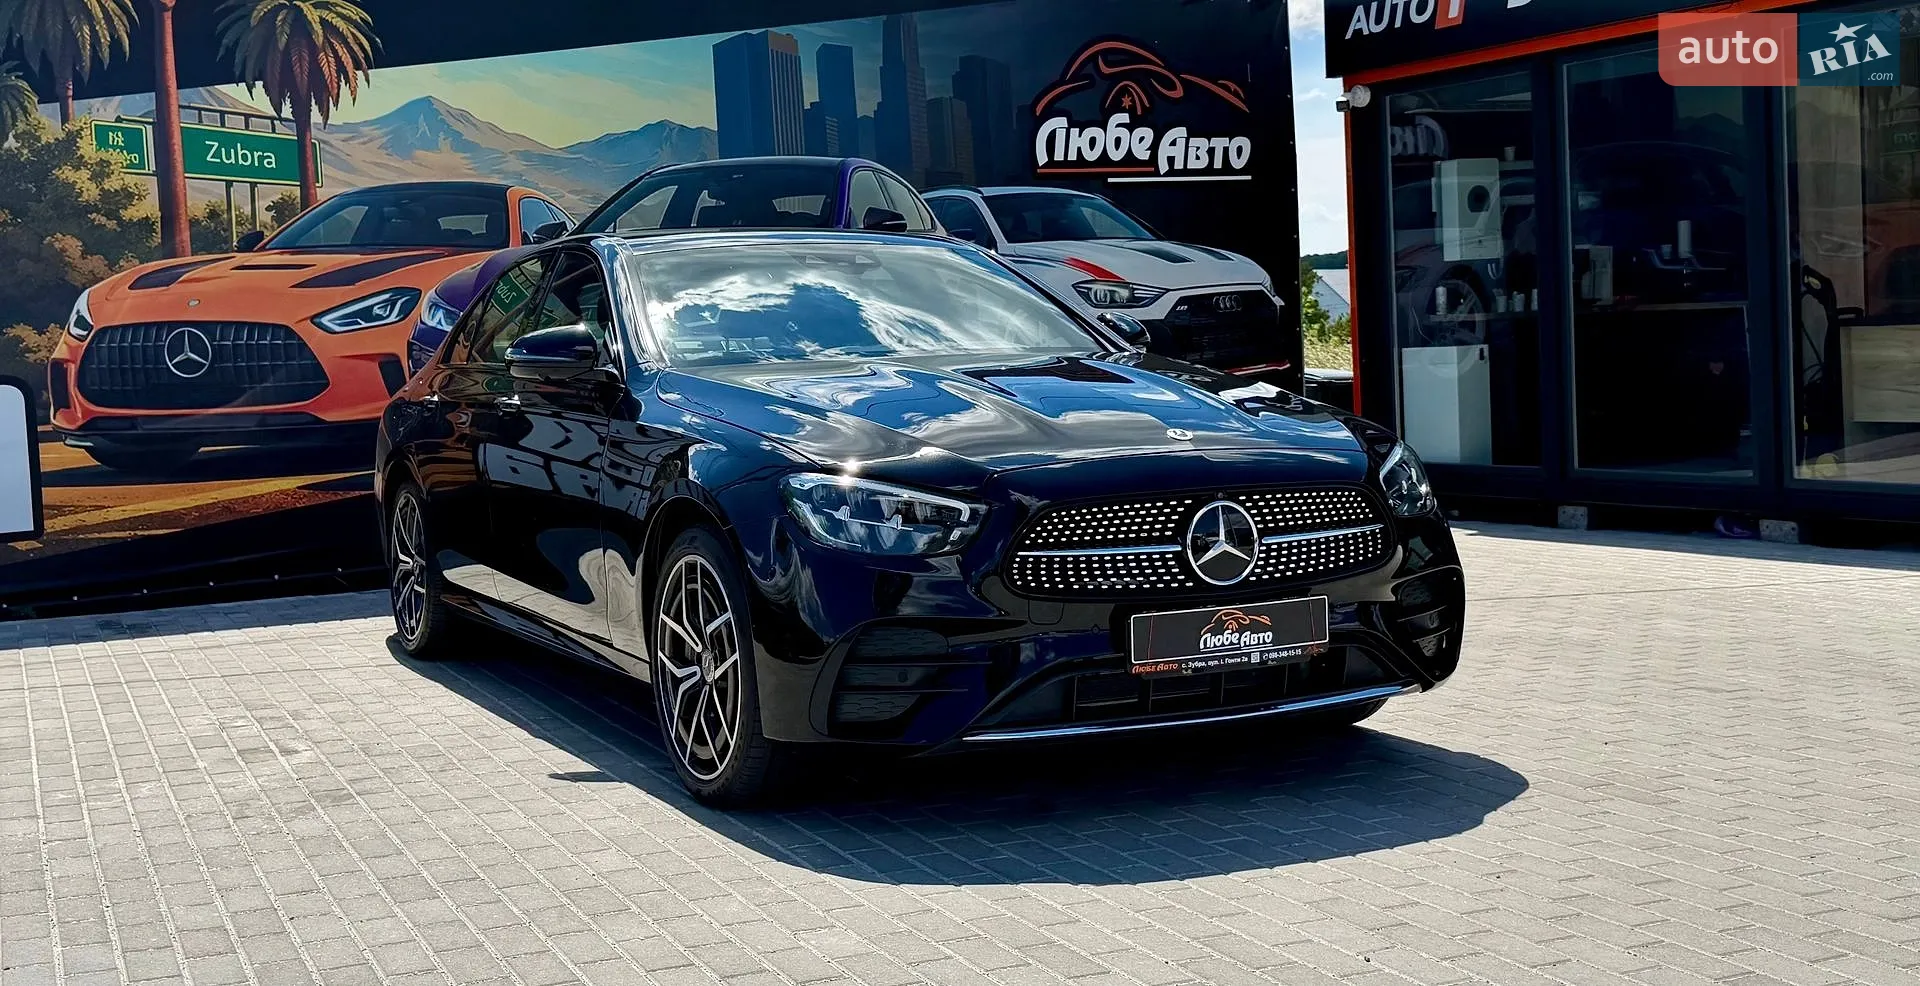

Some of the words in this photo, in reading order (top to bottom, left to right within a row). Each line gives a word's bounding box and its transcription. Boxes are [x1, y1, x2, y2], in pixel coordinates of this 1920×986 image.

[1345, 0, 1434, 39] AUTO
[205, 140, 276, 169] Zubra
[1036, 113, 1154, 167] Любе
[1158, 127, 1252, 175] Авто
[1200, 630, 1240, 649] Любе
[1241, 631, 1273, 648] Авто
